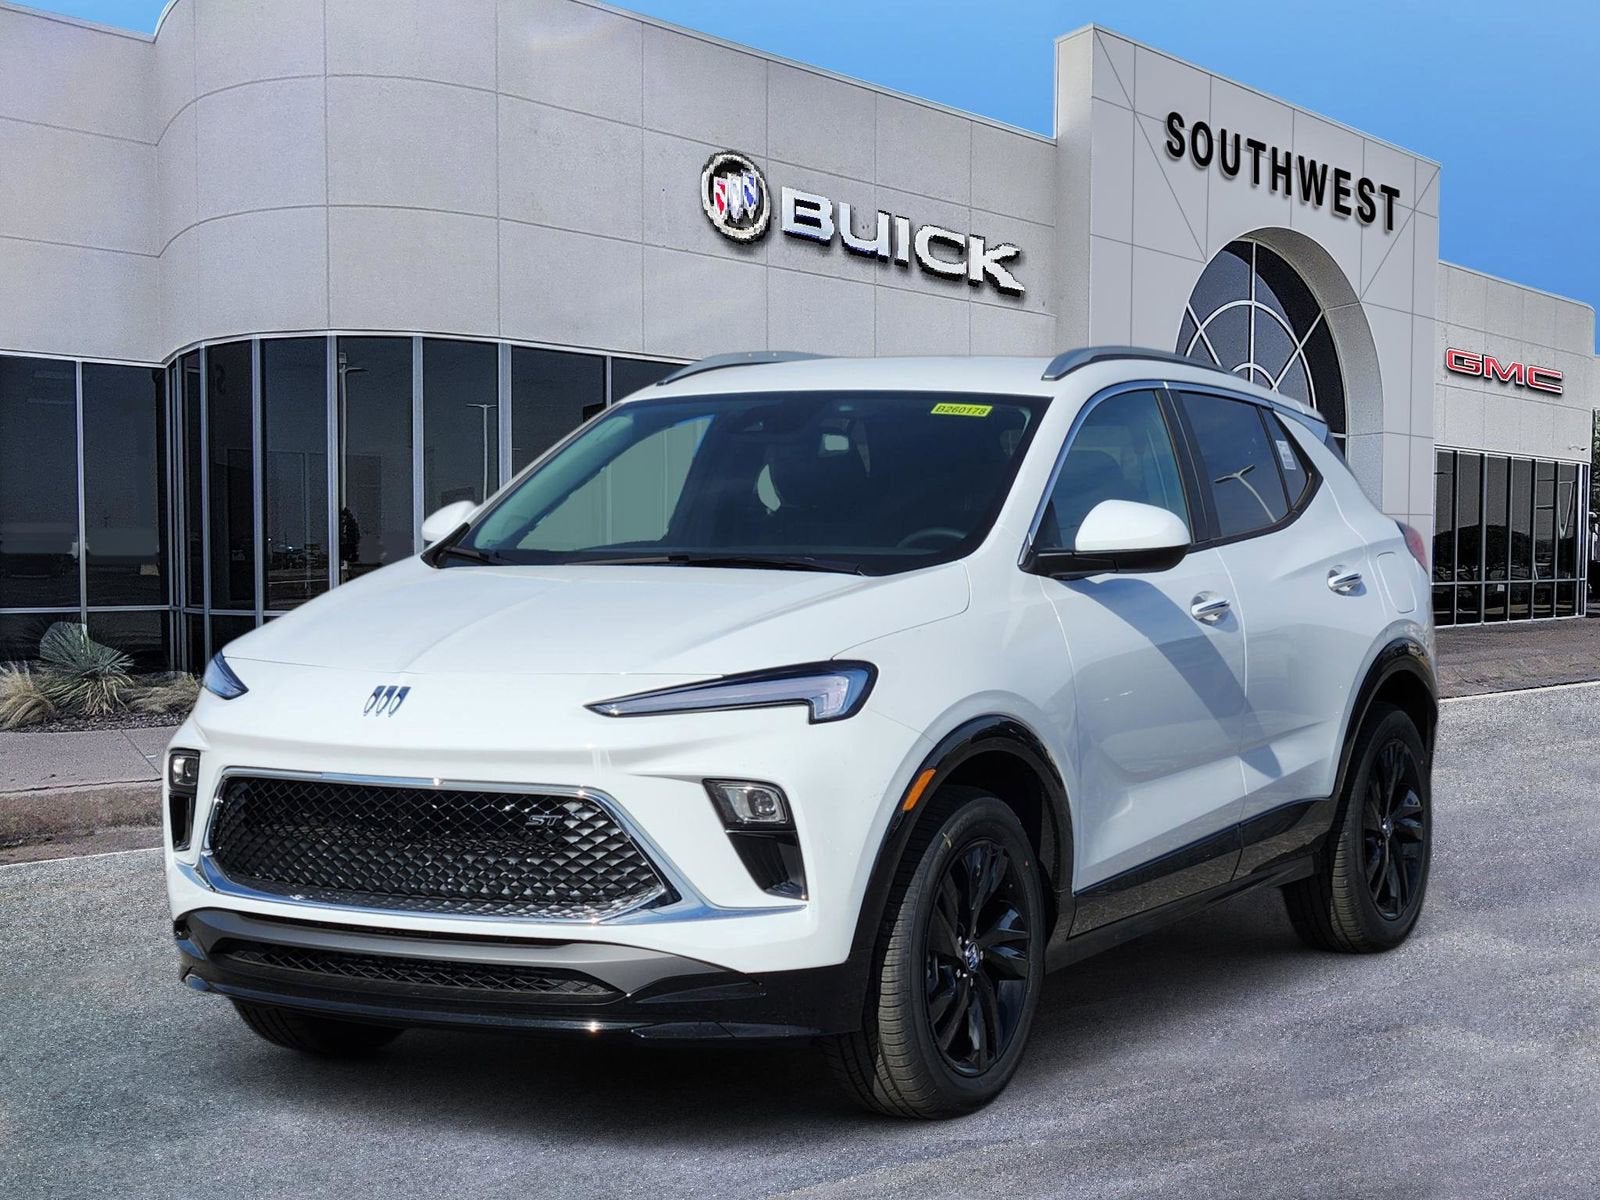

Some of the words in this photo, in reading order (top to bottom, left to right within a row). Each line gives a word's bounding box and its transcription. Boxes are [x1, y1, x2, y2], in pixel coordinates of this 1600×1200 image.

[1166, 111, 1400, 231] SOUTHWEST
[781, 186, 1026, 296] BUICK
[1446, 347, 1563, 394] GMC
[935, 404, 987, 416] B260178
[525, 814, 563, 826] ST
